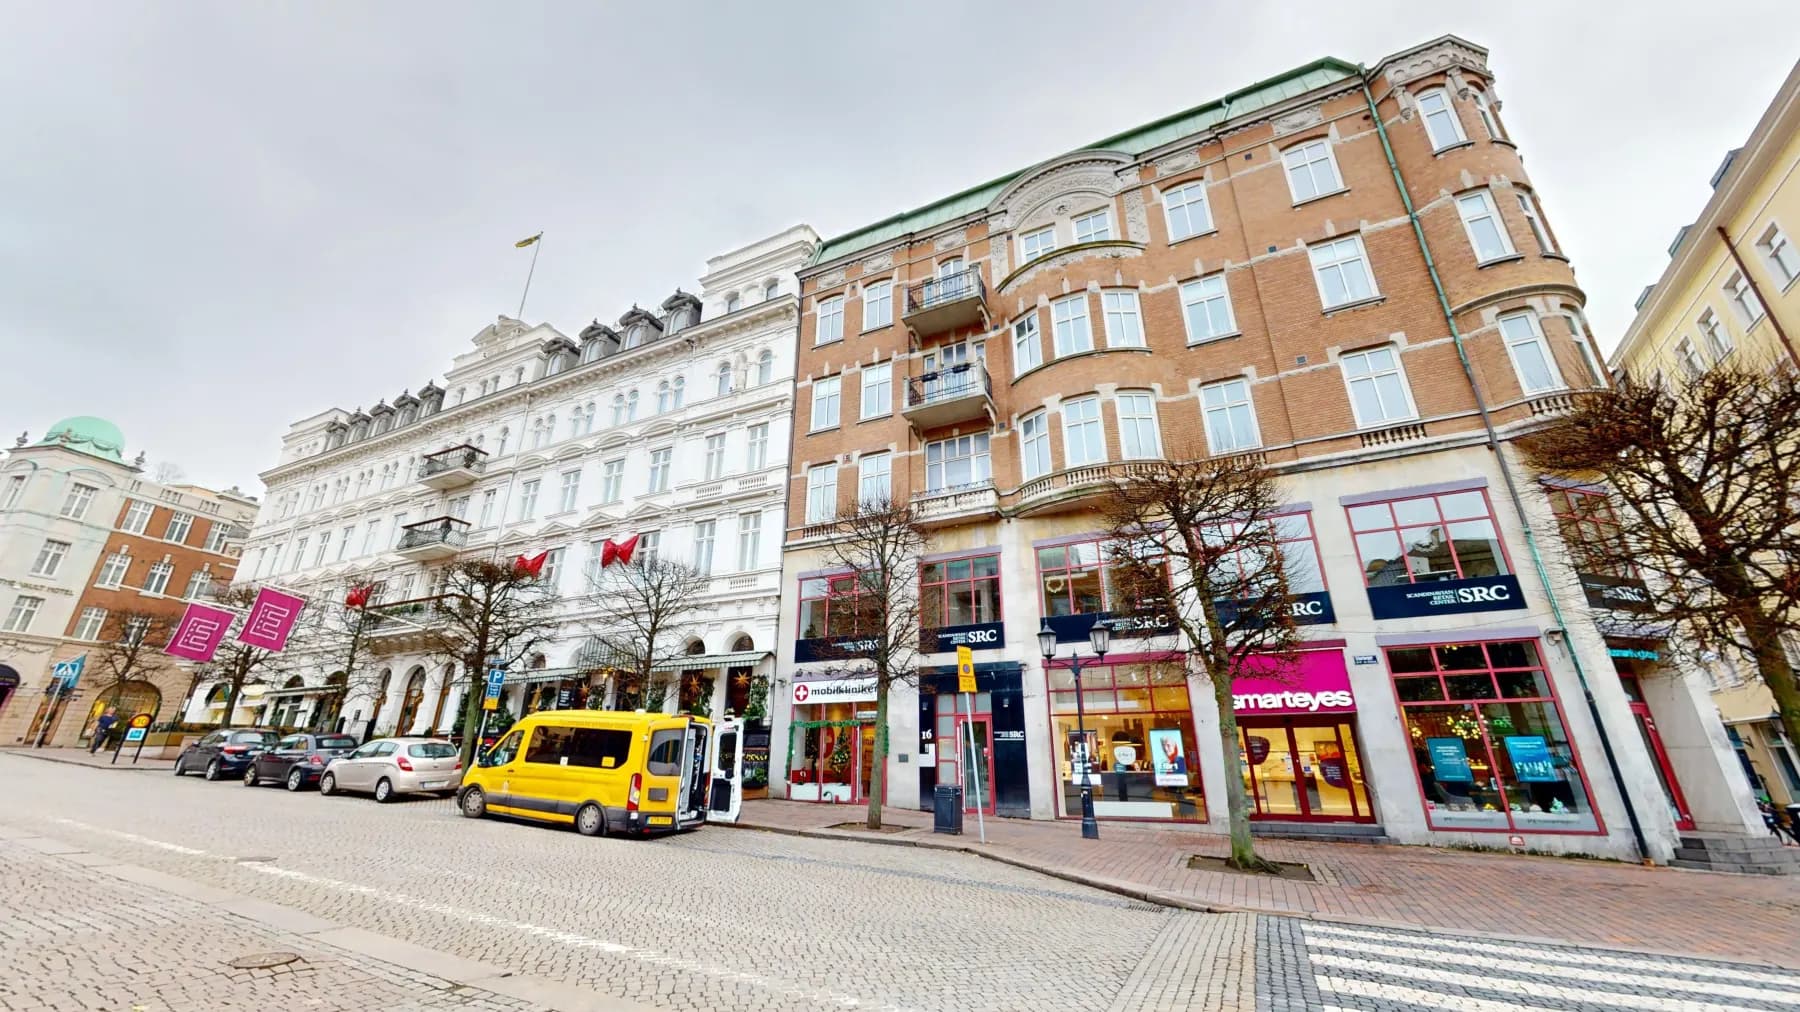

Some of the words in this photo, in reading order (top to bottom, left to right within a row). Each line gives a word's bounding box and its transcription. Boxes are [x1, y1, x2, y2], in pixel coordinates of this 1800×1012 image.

[1406, 590, 1454, 599] SCANDINAVIAN
[1458, 584, 1510, 603] SRC
[968, 629, 997, 643] SRC
[493, 671, 502, 682] P
[921, 729, 932, 740] 16
